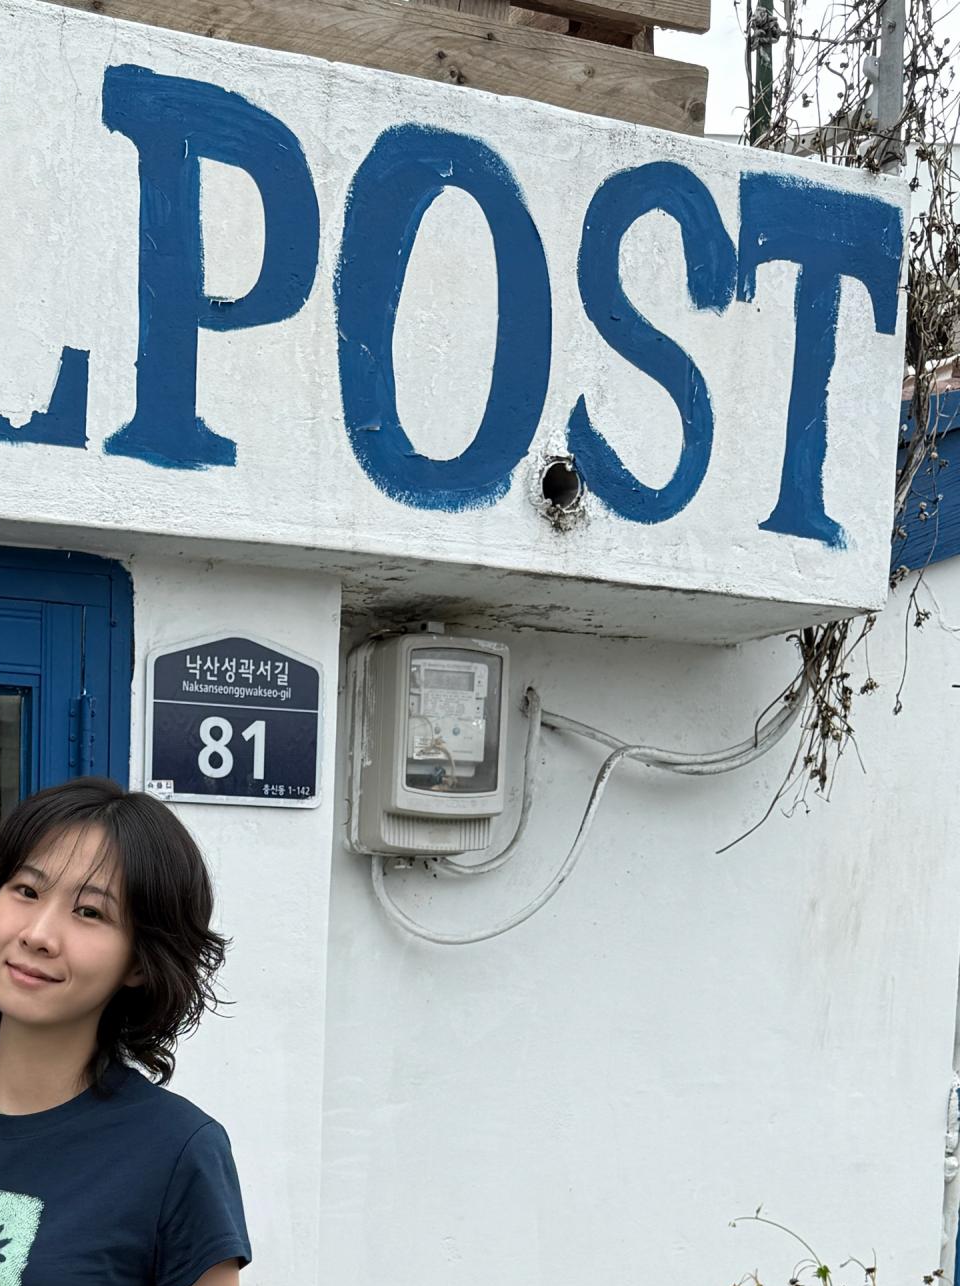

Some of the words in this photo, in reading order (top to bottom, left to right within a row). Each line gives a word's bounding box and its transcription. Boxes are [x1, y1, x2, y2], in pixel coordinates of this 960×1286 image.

[186, 655, 289, 686] 낙산성곽서길
[182, 681, 291, 700] Naksanseonggwakseo-gil
[198, 716, 266, 780] 81
[288, 786, 311, 796] 1-142
